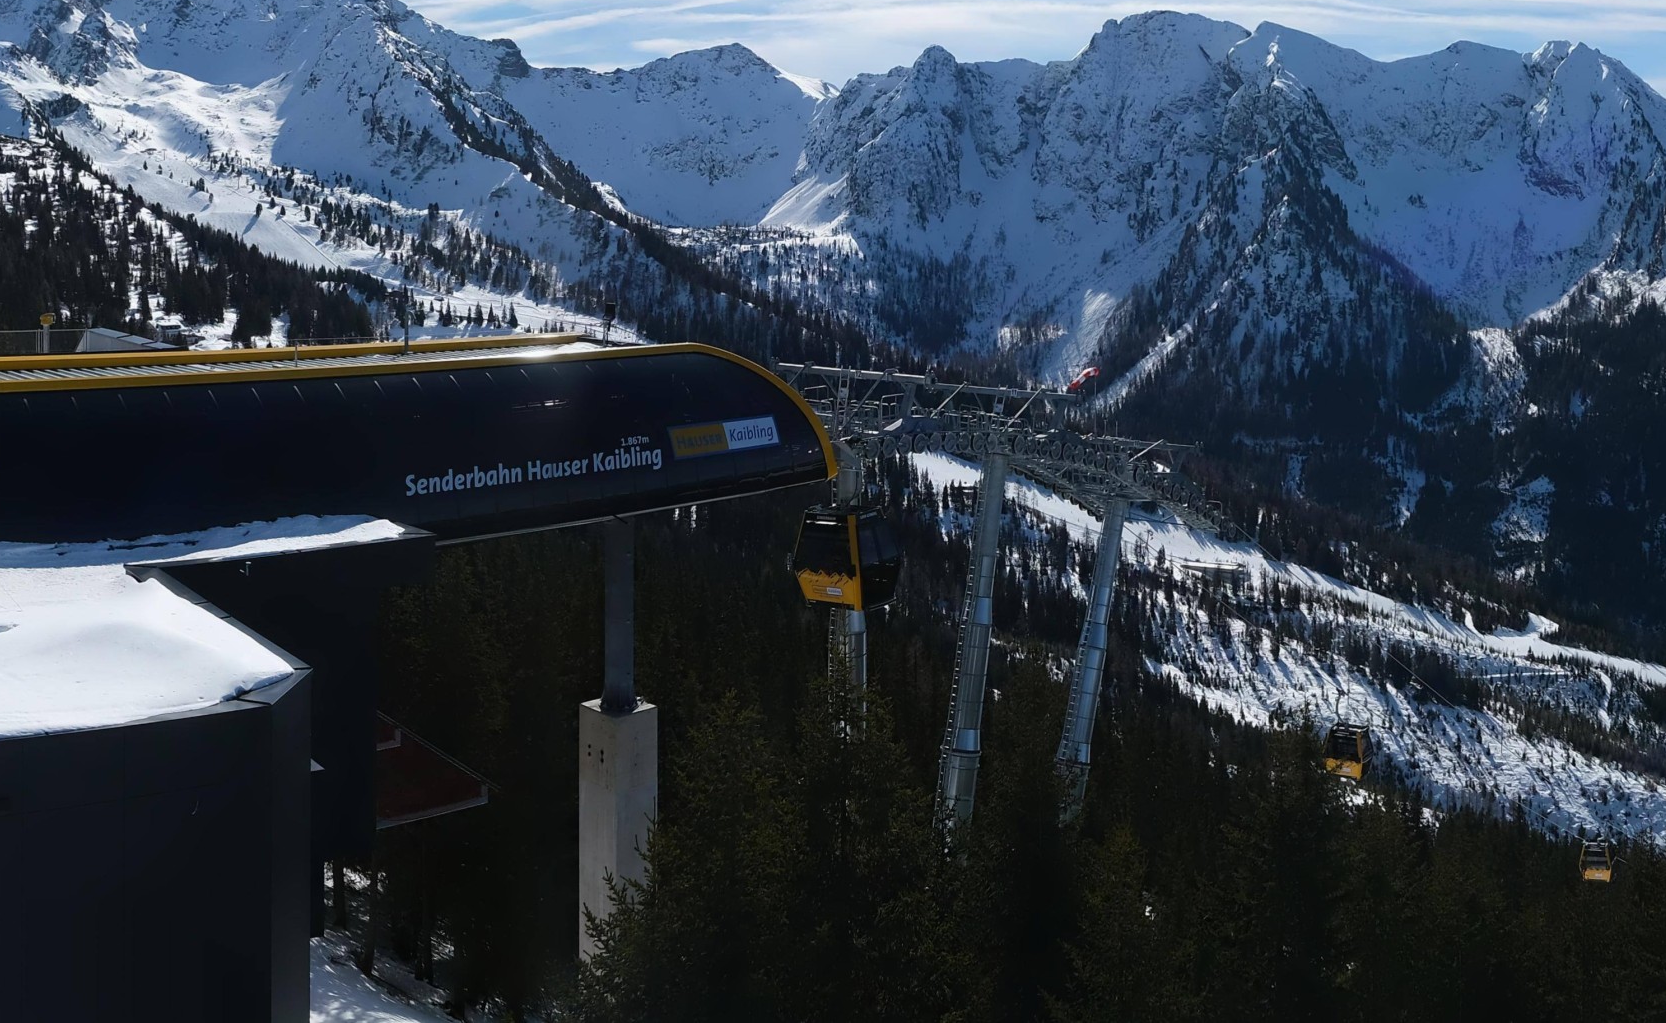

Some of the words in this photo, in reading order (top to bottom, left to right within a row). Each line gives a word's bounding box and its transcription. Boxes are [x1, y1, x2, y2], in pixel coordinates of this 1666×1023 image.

[620, 436, 650, 448] 1.867m
[675, 433, 724, 451] HAUSER
[728, 425, 775, 443] Kaibling
[405, 465, 523, 497] Senderbahn
[527, 457, 590, 481] Hauser
[592, 447, 663, 473] Kaibling
